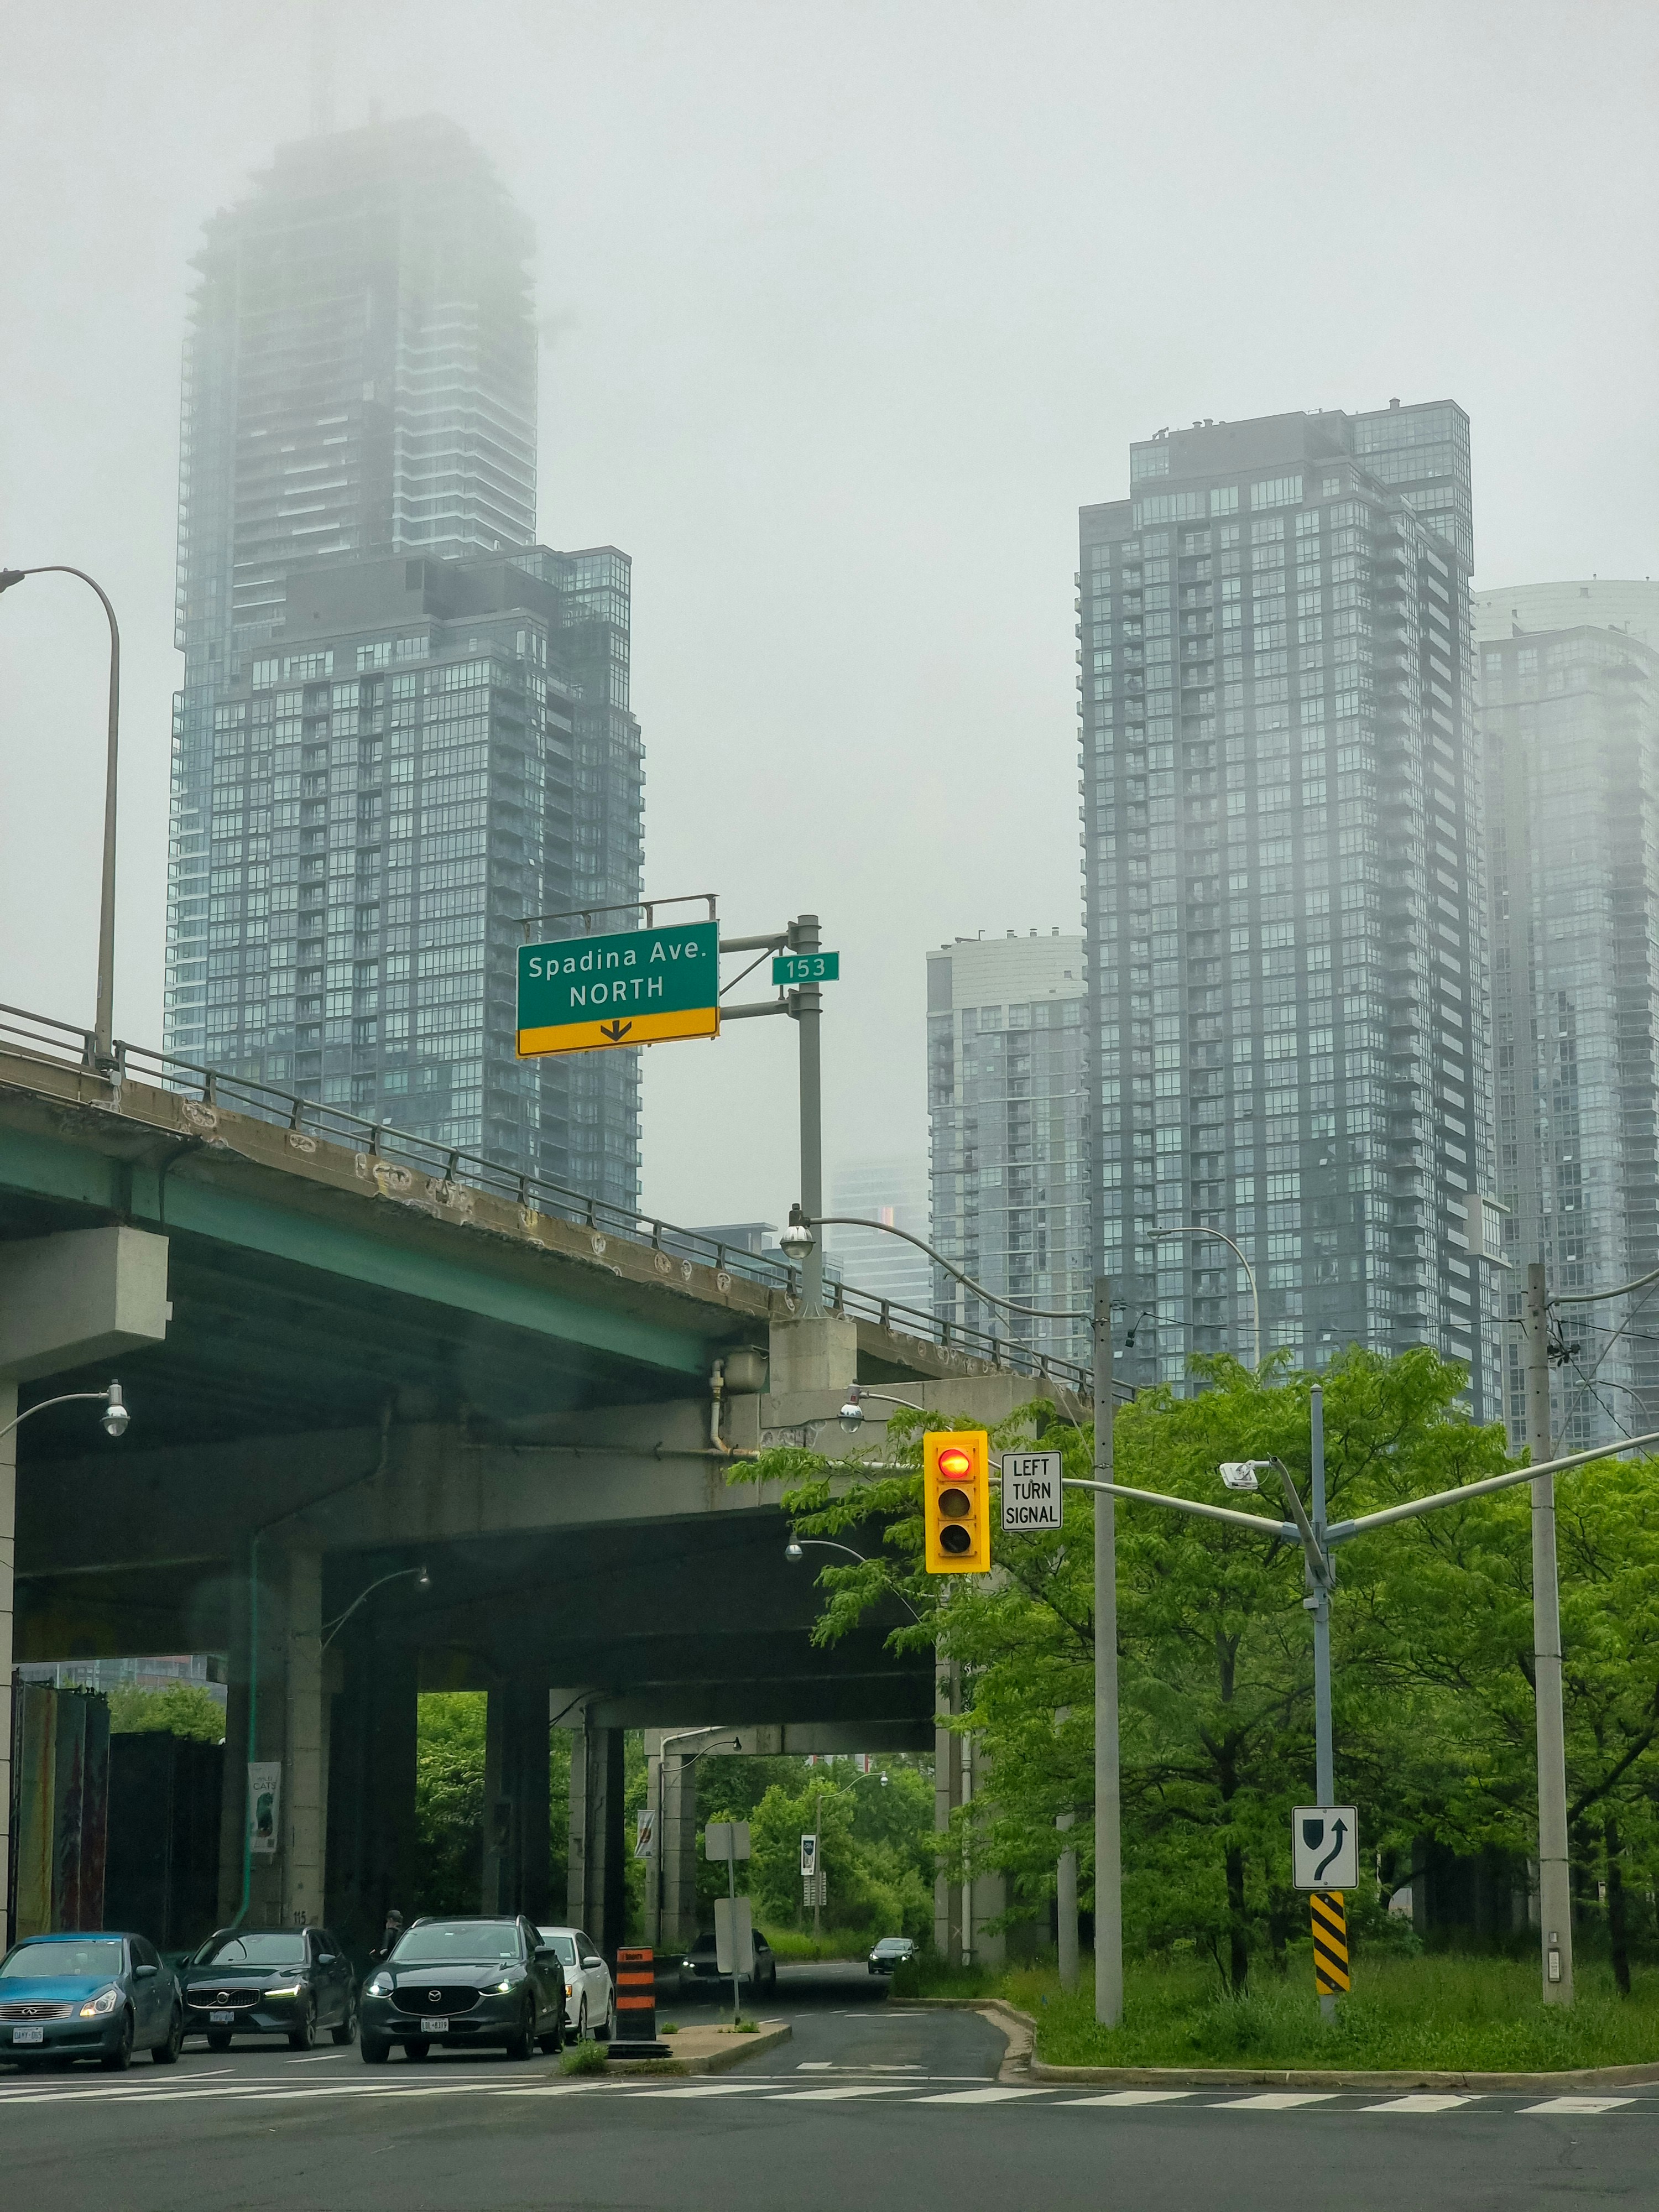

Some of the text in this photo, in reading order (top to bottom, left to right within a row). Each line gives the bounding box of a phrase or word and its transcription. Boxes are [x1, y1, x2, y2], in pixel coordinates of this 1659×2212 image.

[529, 942, 707, 981] Spadina Ave.
[786, 958, 826, 978] 153
[570, 976, 662, 1007] NORTH
[1014, 1458, 1050, 1477] LEFT
[1013, 1482, 1051, 1500] TURN
[1006, 1505, 1058, 1524] SIGNAL
